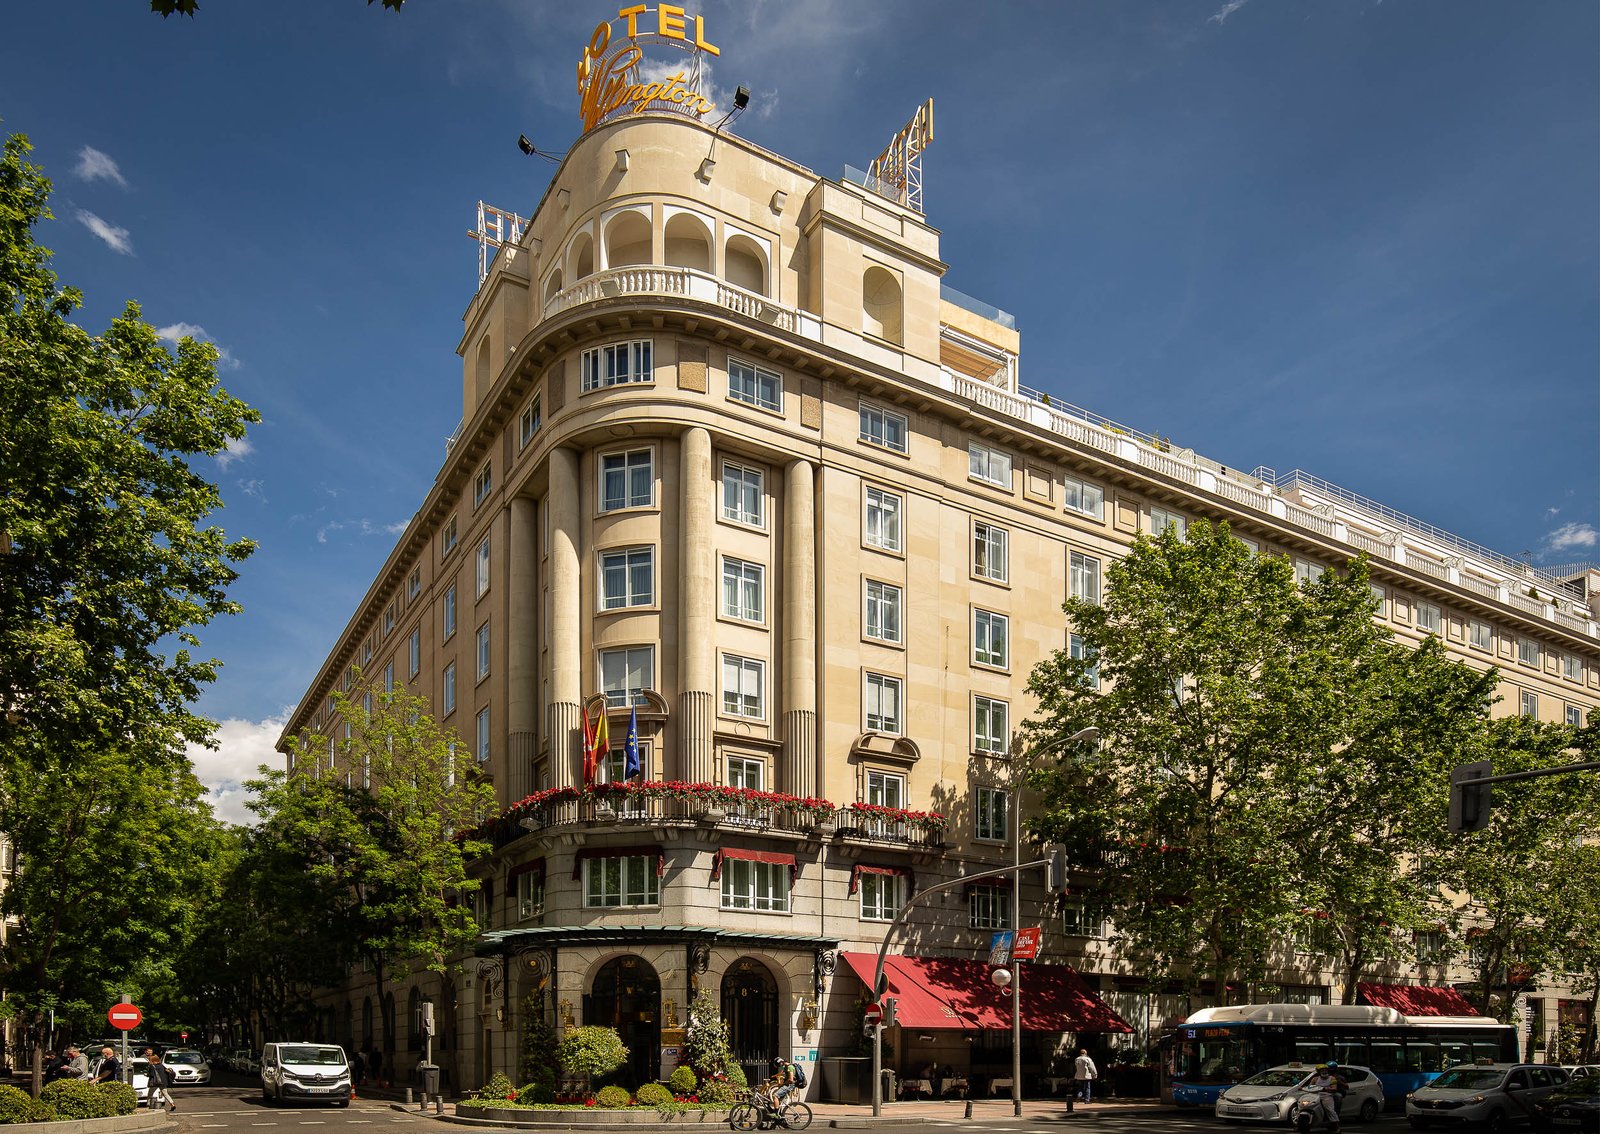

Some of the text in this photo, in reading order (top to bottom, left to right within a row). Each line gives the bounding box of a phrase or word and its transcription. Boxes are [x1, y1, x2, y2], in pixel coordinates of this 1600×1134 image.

[577, 4, 720, 95] HOTEL
[742, 988, 747, 996] 8
[1187, 1029, 1196, 1038] 51
